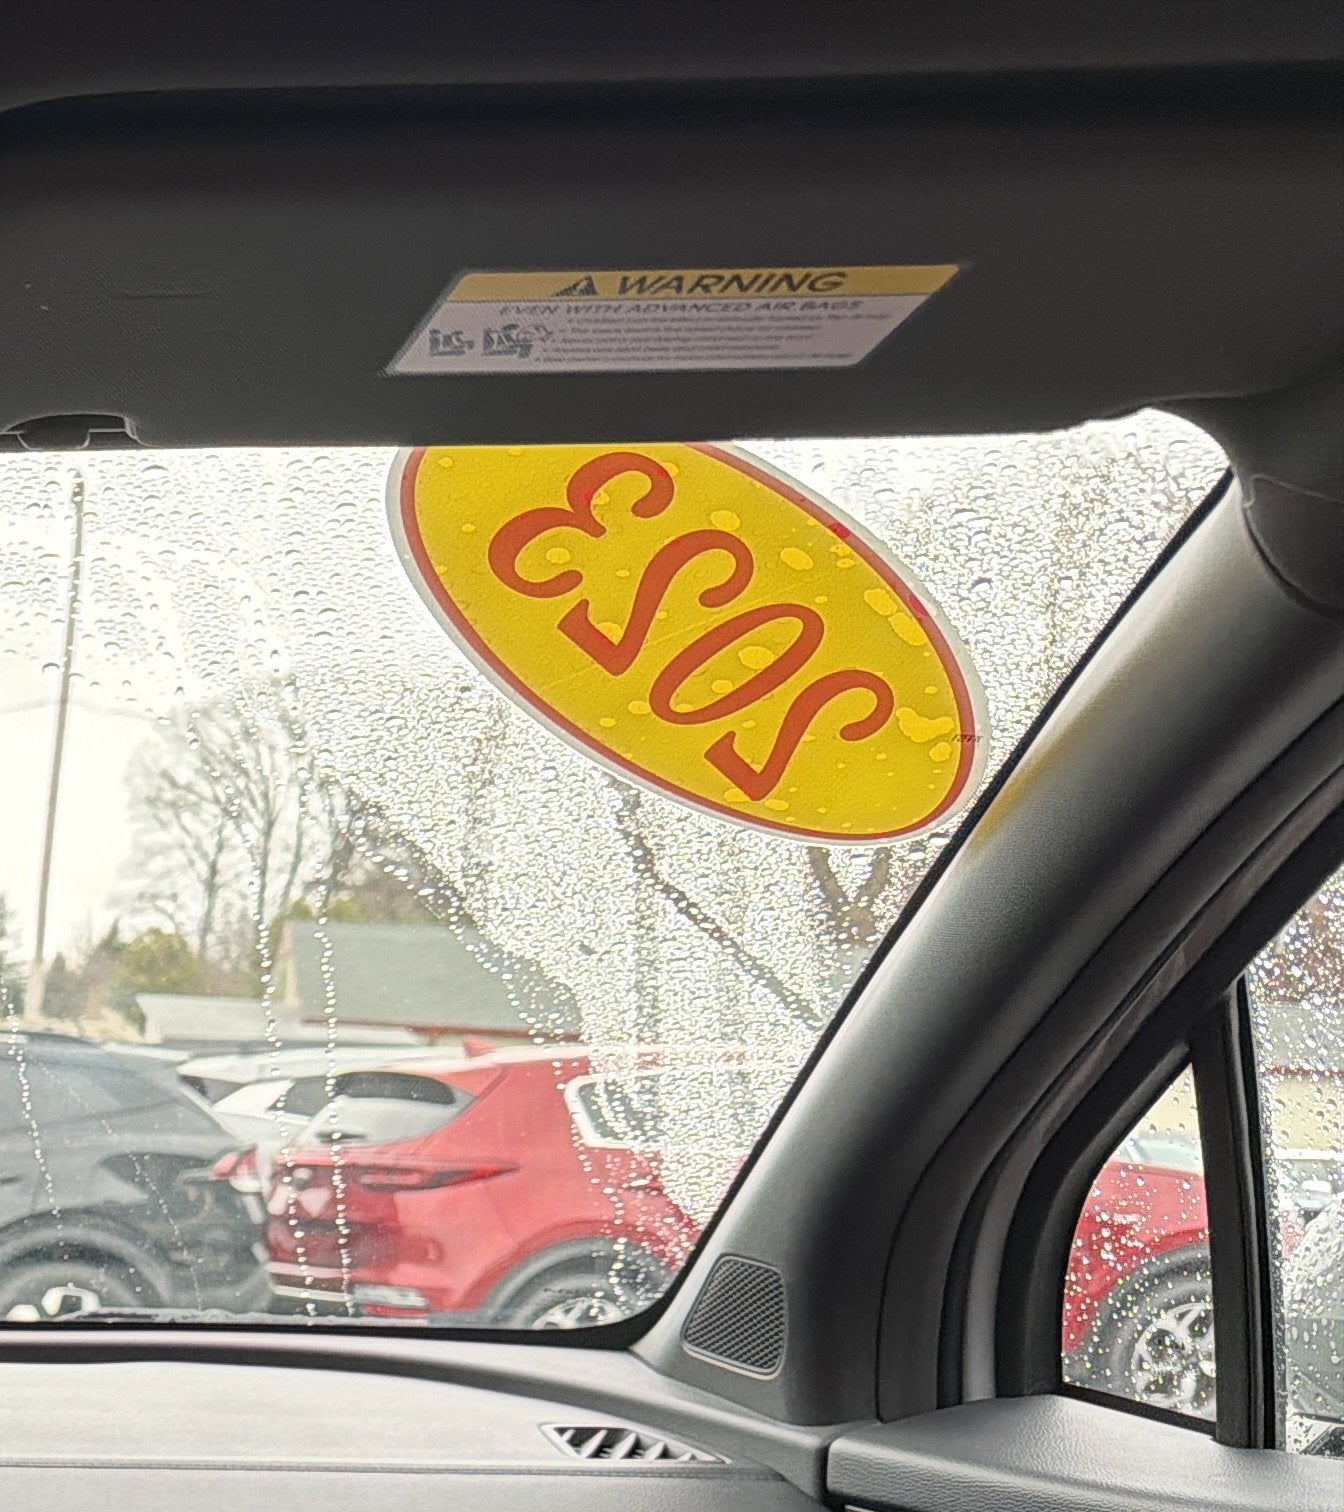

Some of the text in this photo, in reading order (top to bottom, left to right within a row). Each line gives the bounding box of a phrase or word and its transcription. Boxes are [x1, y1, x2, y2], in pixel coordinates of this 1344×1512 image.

[617, 272, 848, 295] WARNING
[564, 303, 627, 316] WITH
[629, 301, 752, 315] ADVANCED
[755, 300, 797, 313] AIR
